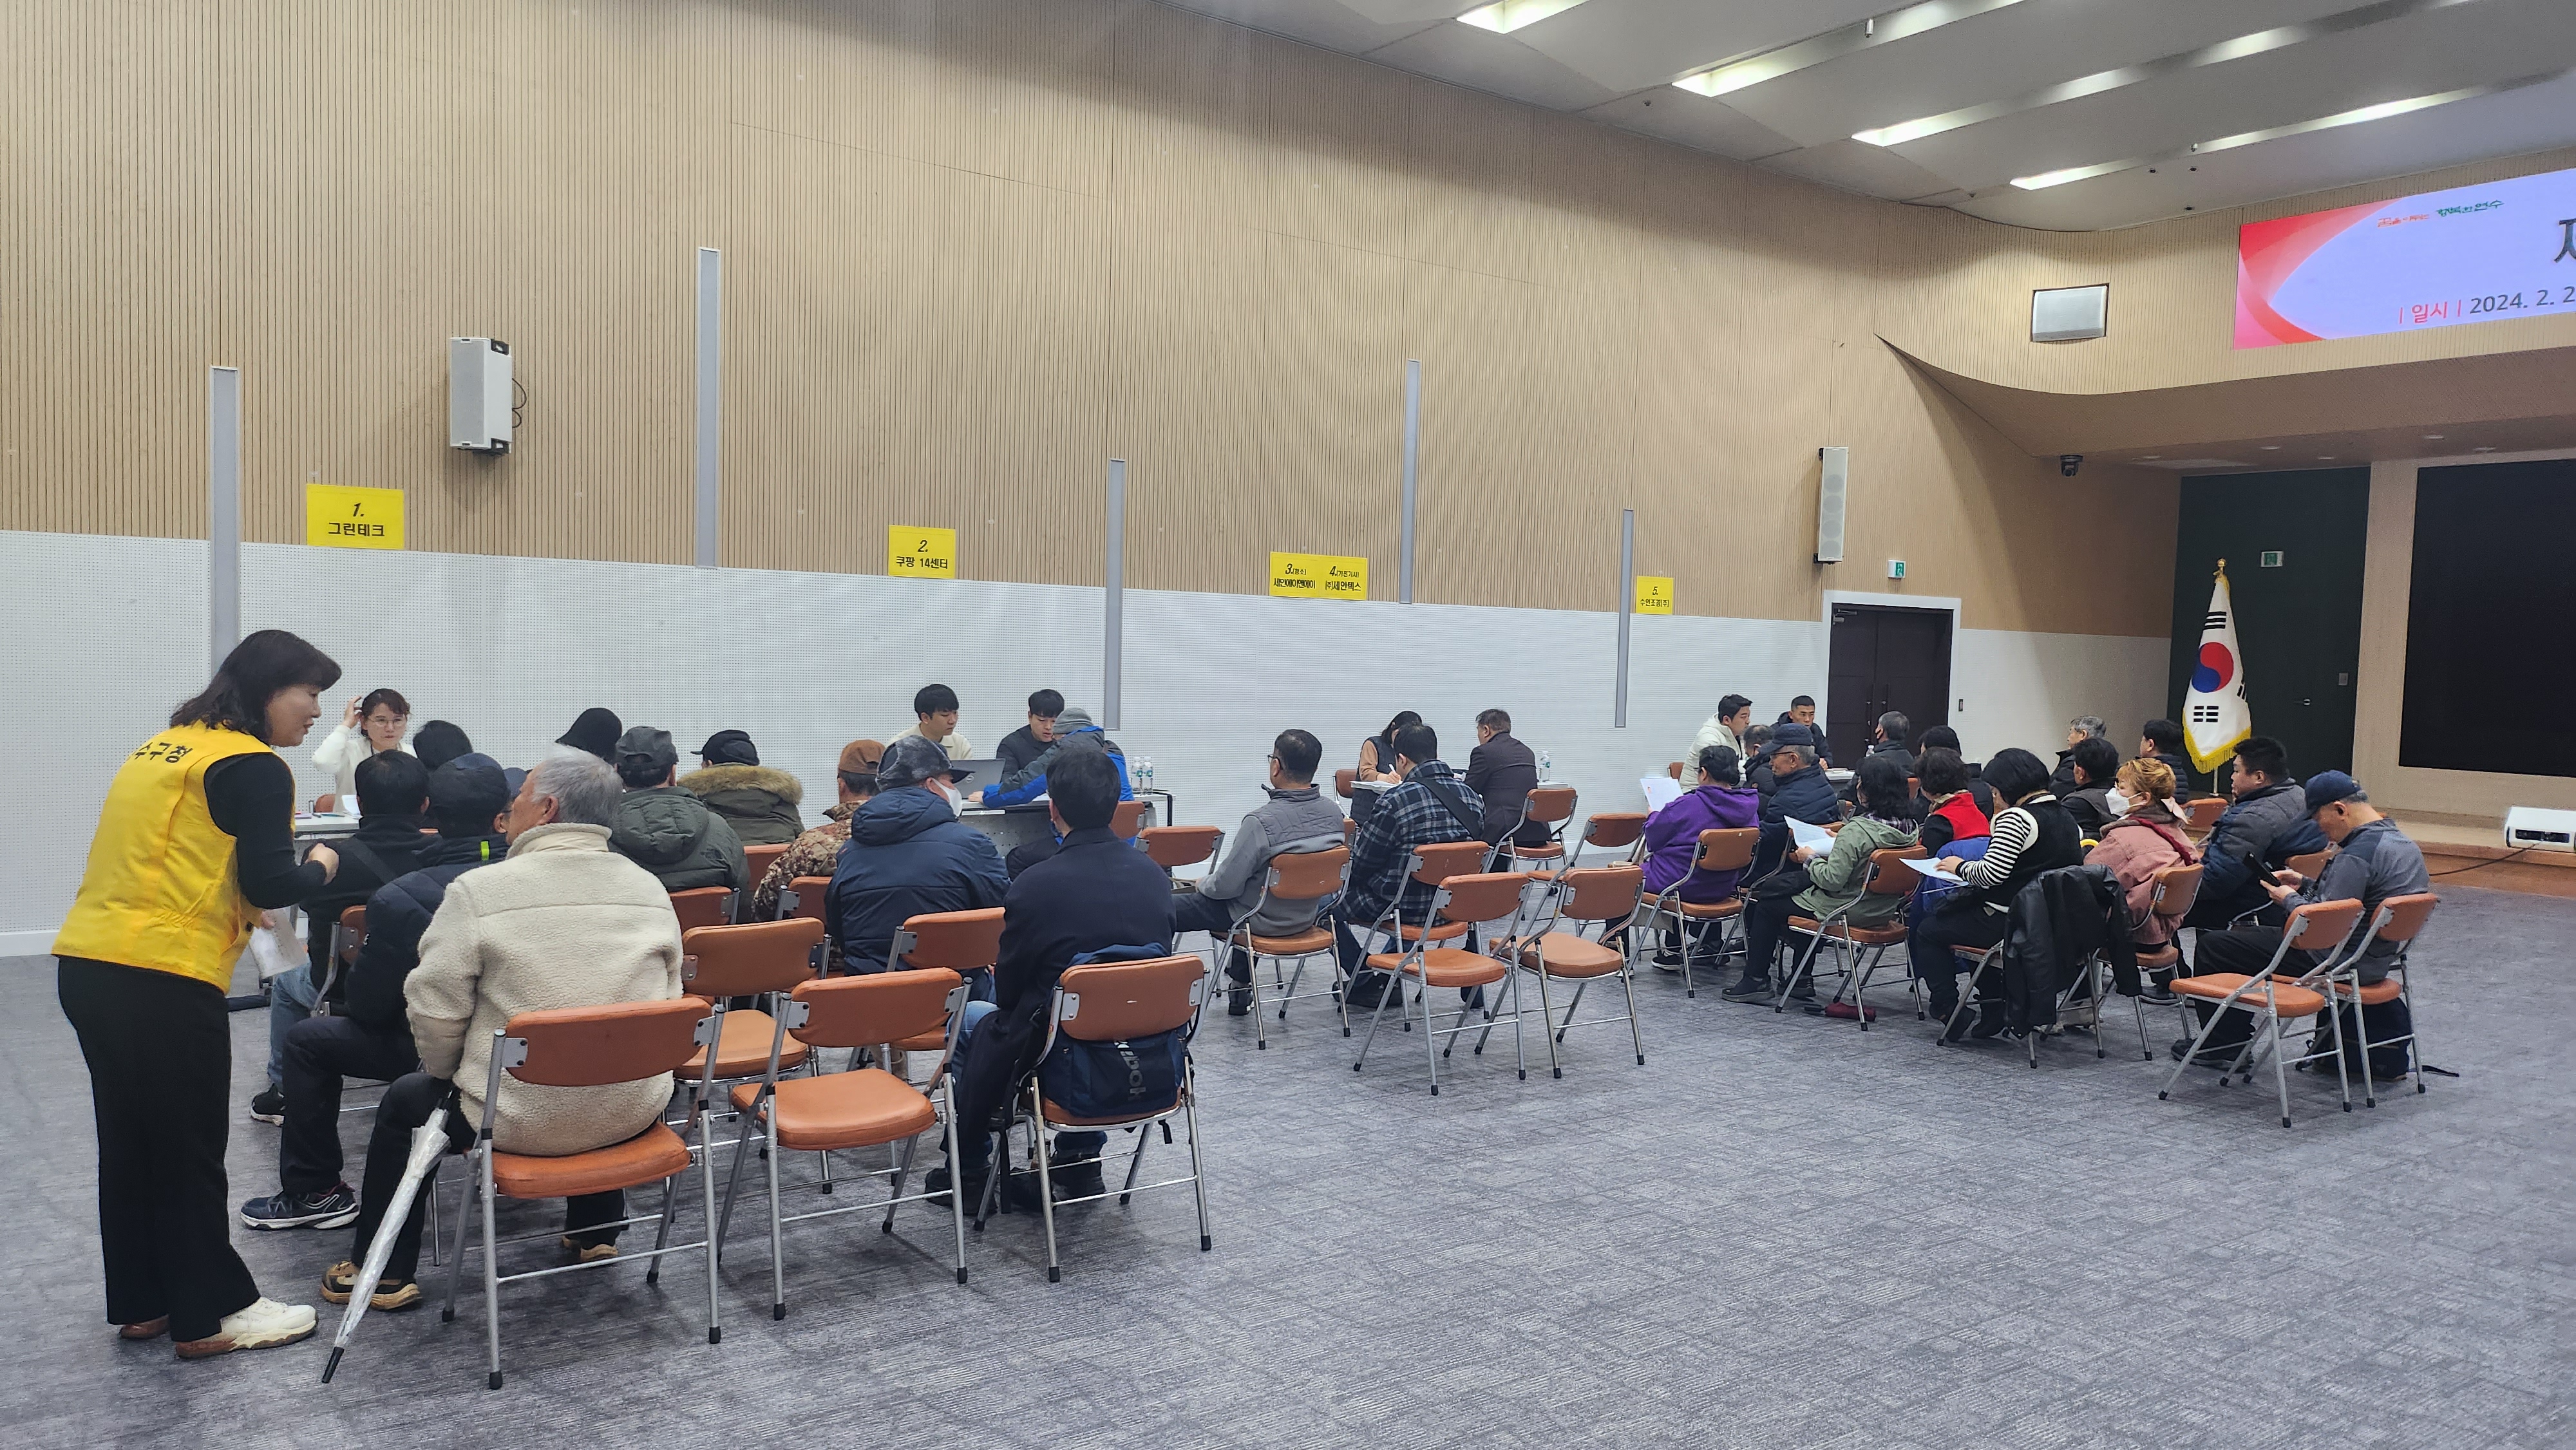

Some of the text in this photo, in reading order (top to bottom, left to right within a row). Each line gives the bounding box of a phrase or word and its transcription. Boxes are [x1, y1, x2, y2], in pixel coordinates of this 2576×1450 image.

[2469, 292, 2528, 314] 2024.
[2536, 289, 2555, 306] 2.
[353, 502, 365, 517] 1.
[328, 522, 384, 536] 그린테크
[918, 540, 928, 552] 2.
[896, 556, 948, 569] 쿠팡 14센터
[1652, 586, 1658, 596] 5.
